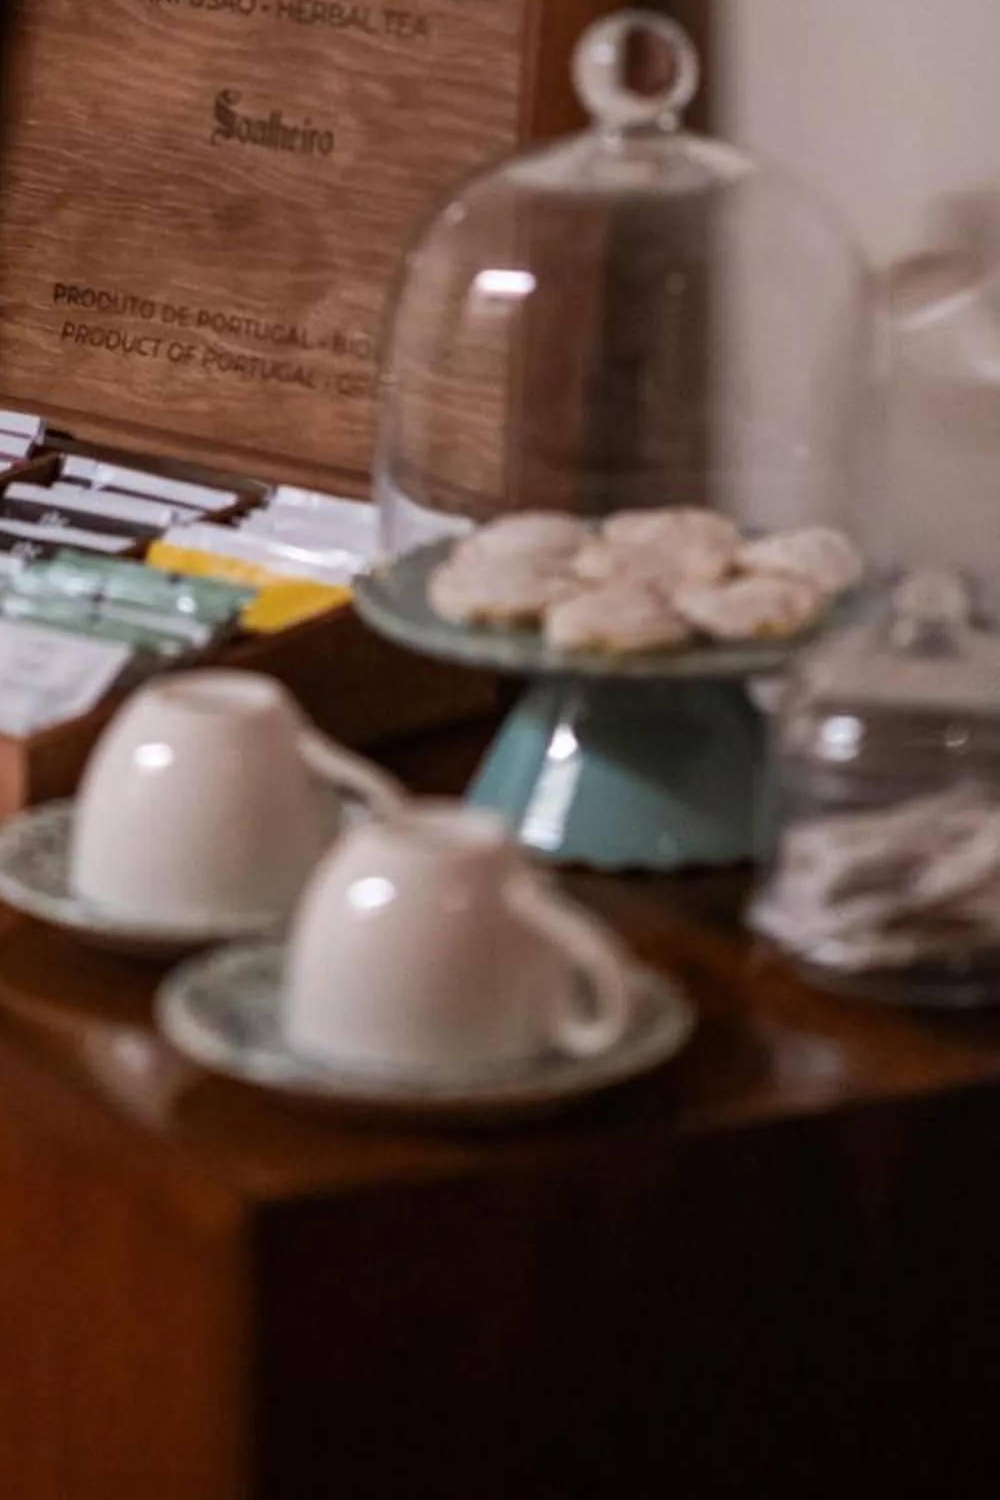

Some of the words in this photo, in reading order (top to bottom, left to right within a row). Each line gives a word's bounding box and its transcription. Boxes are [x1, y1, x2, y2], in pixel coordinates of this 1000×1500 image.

[276, 0, 379, 34] HERBAL
[383, 9, 429, 39] TEA
[53, 282, 156, 320] PRODUTO
[161, 303, 190, 328] DE
[196, 309, 314, 350] PORTUGAL
[61, 319, 162, 358] PRODUCT
[167, 341, 197, 364] OF
[201, 346, 316, 390] PORTUGAL
